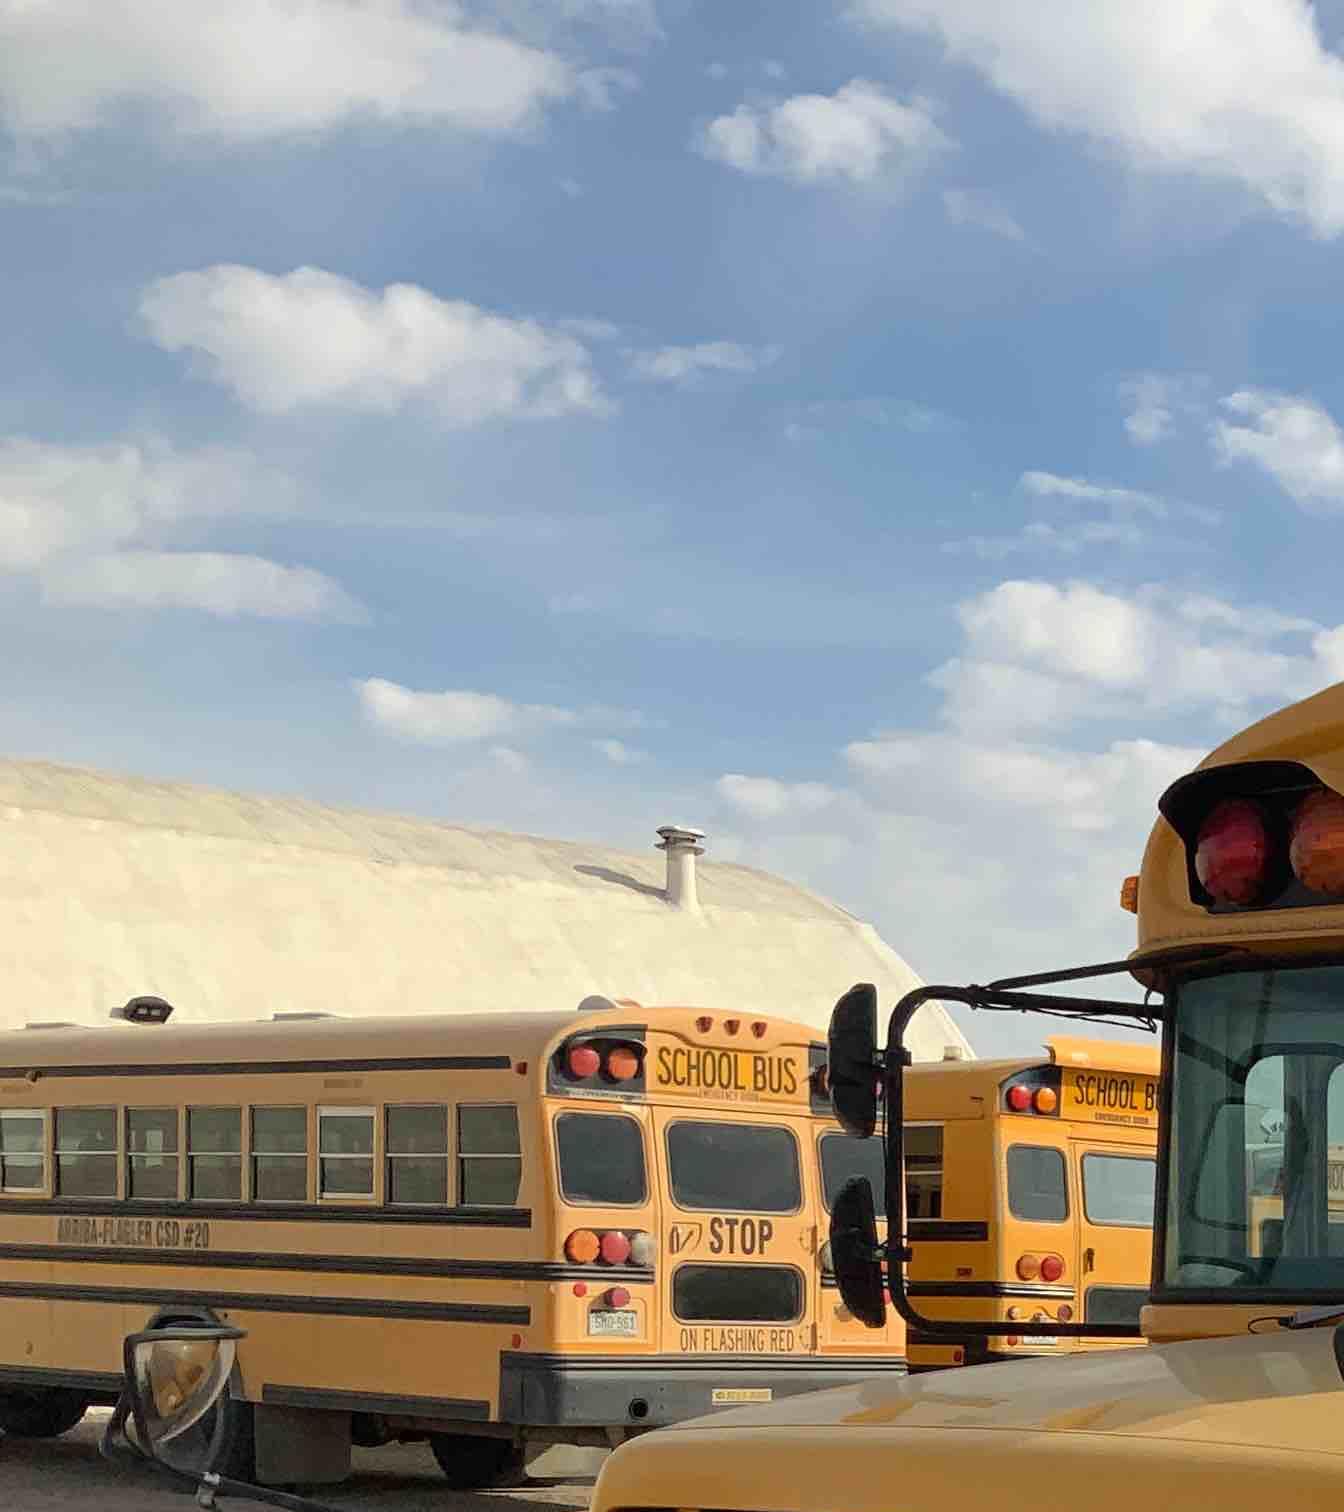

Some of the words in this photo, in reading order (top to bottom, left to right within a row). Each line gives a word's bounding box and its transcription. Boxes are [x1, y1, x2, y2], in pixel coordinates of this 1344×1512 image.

[657, 1046, 746, 1091] SCHOOL
[753, 1055, 798, 1095] BUS
[1074, 1074, 1138, 1110] SCHOOL
[156, 1220, 180, 1249] CSD
[183, 1222, 210, 1250] #20
[709, 1216, 774, 1256] STOP
[680, 1328, 698, 1352] ON
[703, 1328, 765, 1353] FLASHING
[769, 1329, 795, 1353] RED
